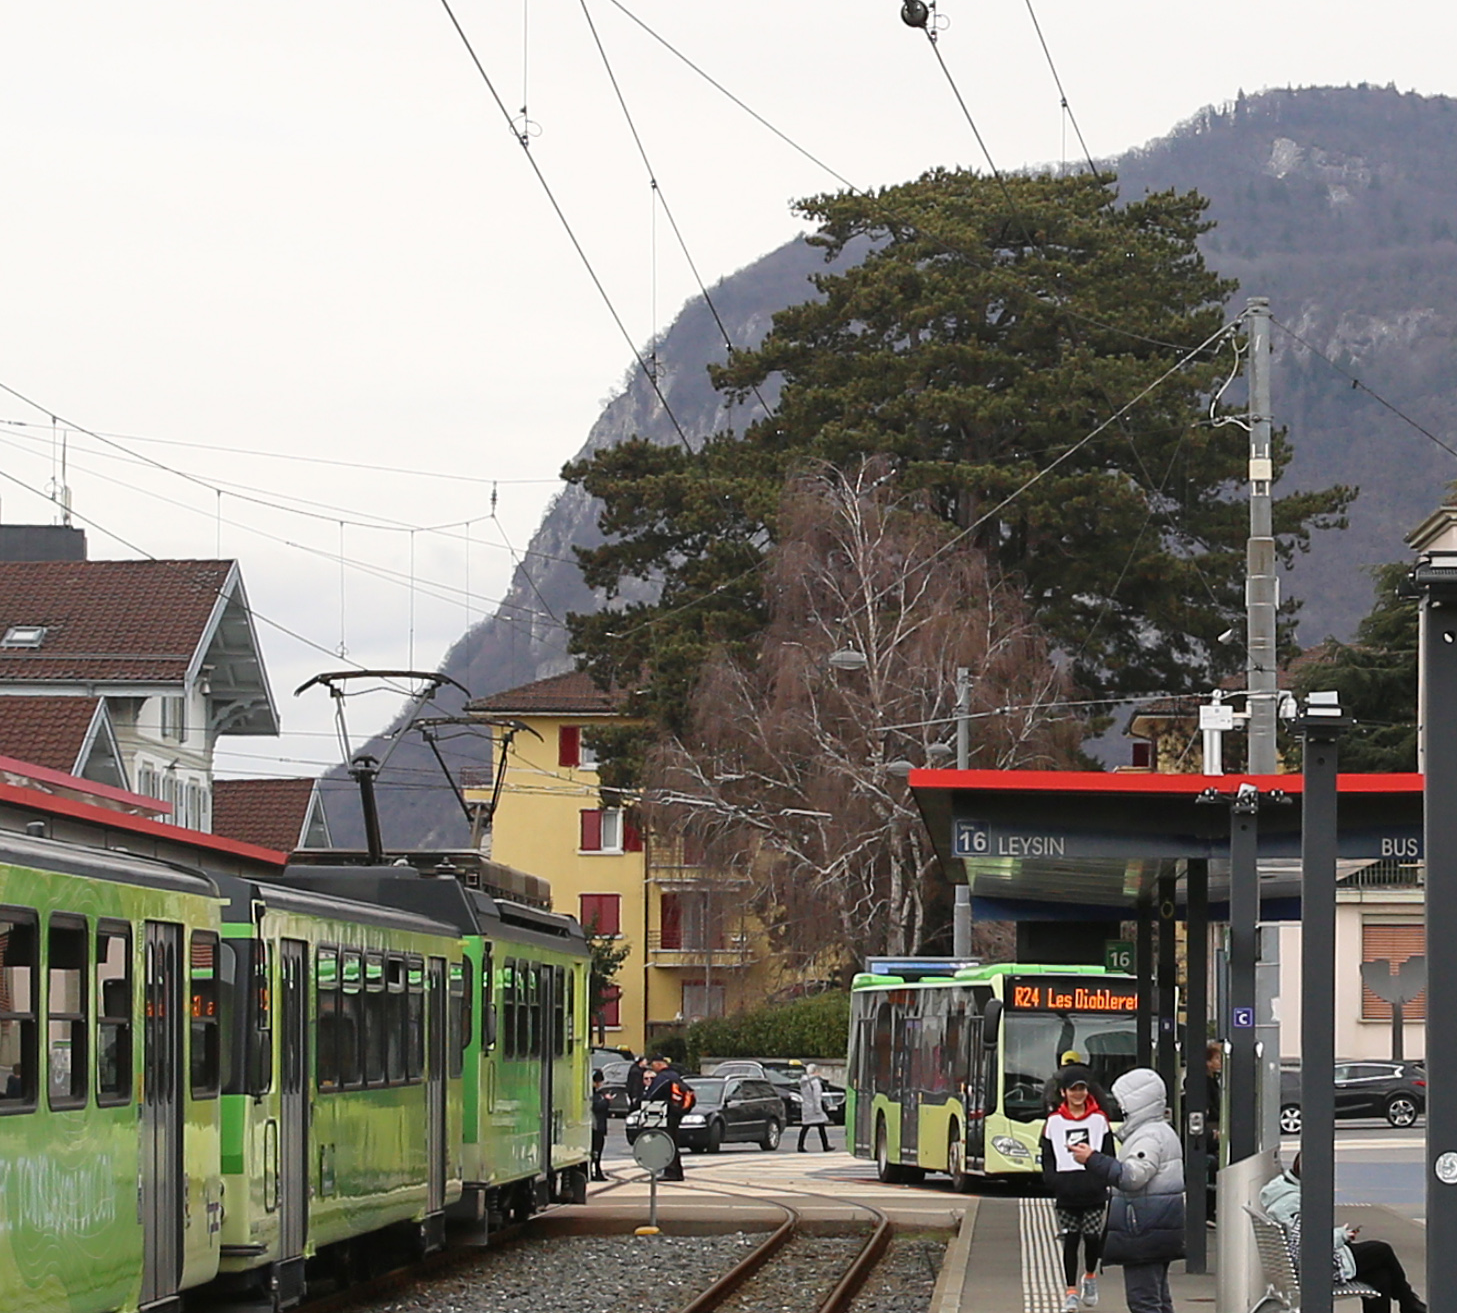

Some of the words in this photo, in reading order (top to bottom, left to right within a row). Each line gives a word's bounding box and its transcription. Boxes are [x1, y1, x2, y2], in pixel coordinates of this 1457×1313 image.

[959, 831, 987, 852] 16
[998, 836, 1064, 856] LEYSIN
[1381, 838, 1419, 857] BUS
[1110, 951, 1130, 967] 16
[1015, 987, 1040, 1007] R24
[1048, 988, 1072, 1008] Les
[1238, 1013, 1248, 1025] C
